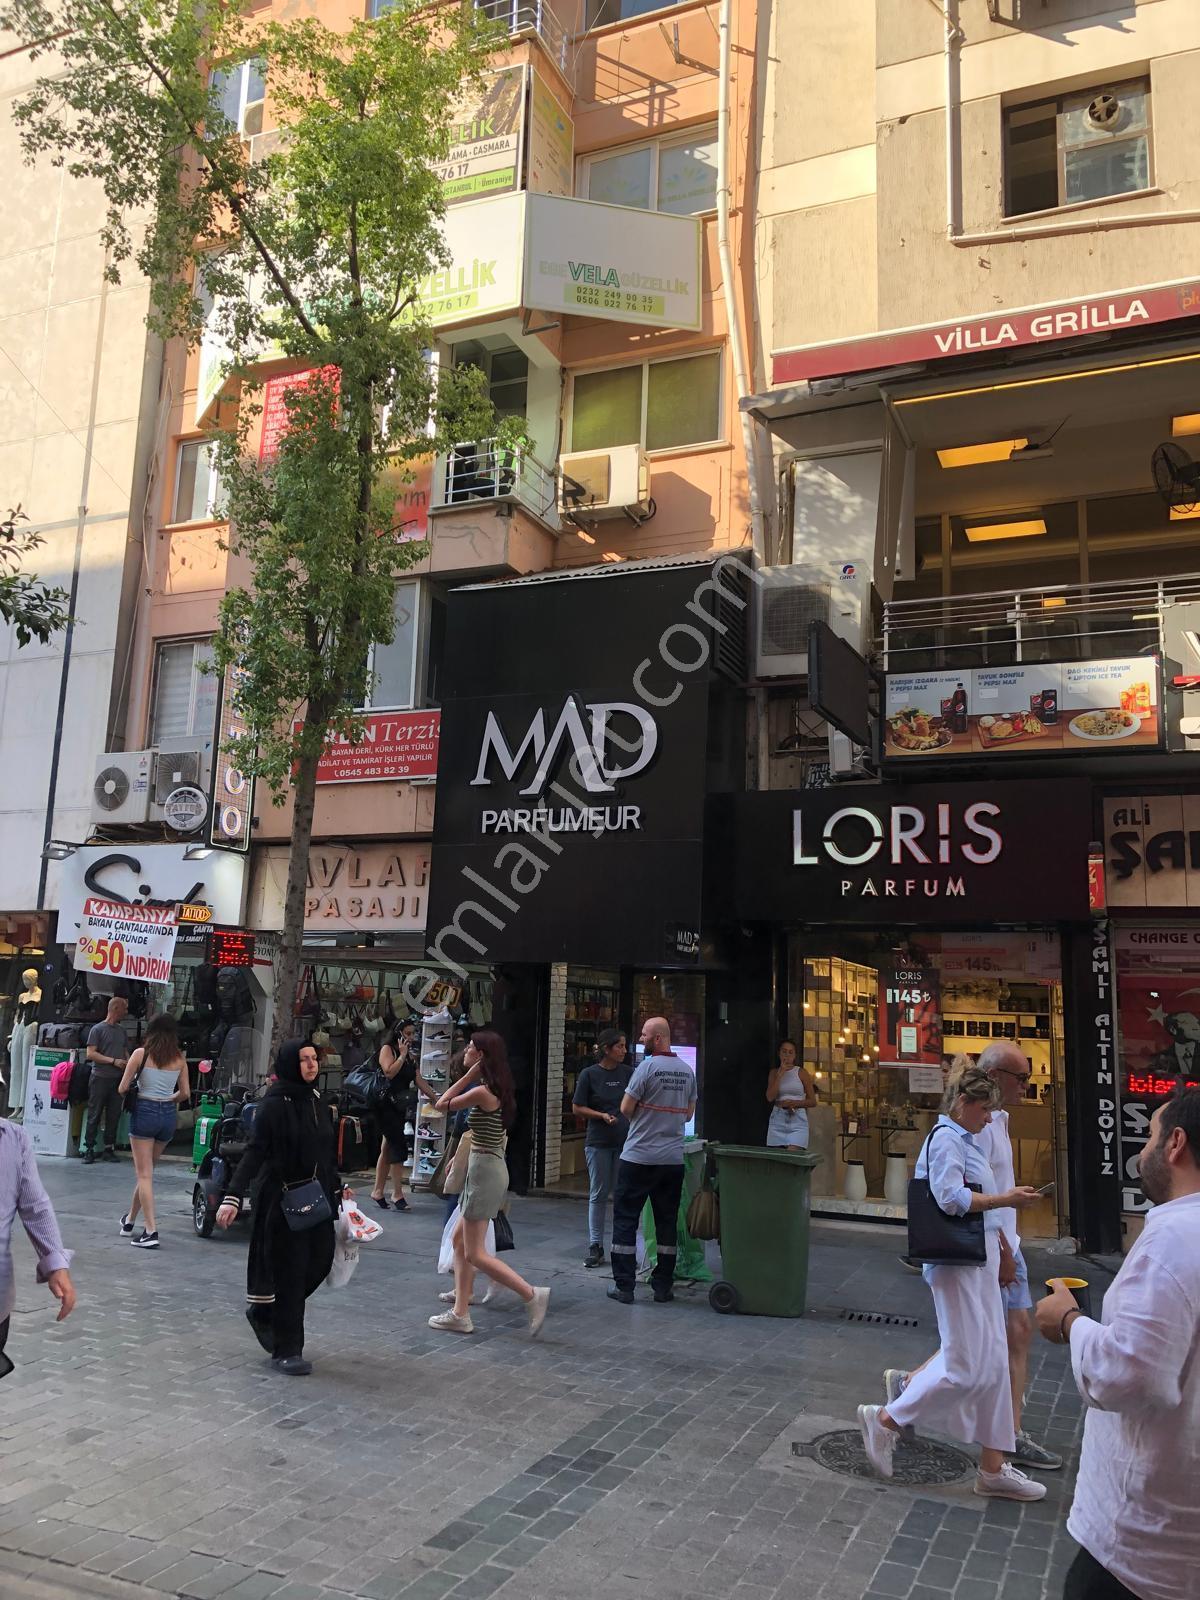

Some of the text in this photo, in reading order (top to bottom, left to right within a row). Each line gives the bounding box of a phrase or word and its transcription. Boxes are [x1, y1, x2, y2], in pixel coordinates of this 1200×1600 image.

[473, 139, 510, 156] CASMARA
[458, 163, 469, 177] 17
[567, 260, 621, 289] VELA
[457, 294, 471, 308] 17
[576, 286, 653, 304] 0232 249 00 35
[576, 295, 653, 313] 0506 022 76 17
[934, 298, 1150, 353] VİLLA GRİLLA
[331, 749, 354, 757] BAYAN
[375, 745, 394, 753] KÜRK
[395, 744, 410, 752] HER
[411, 741, 434, 751] TÜRLÜ
[469, 694, 659, 796] MAD
[317, 759, 340, 768] ADİLAT
[353, 757, 382, 766] TAMİRAT
[384, 755, 405, 764] İŞLERİ
[406, 754, 433, 762] YAPILIR
[340, 765, 410, 777] 0545 483 82 39
[481, 804, 641, 834] PARFUMEUR
[1112, 803, 1150, 827] ALİ
[792, 801, 1002, 865] LORIS
[841, 875, 966, 896] PARFUM
[89, 899, 177, 925] KAMPANYA
[88, 917, 174, 937] BAYAN ÇANTALARINDA
[1130, 932, 1188, 944] CHANGE
[125, 949, 171, 981] İNDİRİM
[896, 971, 922, 981] LORIS
[1095, 1014, 1113, 1085] ALTIN
[1098, 1098, 1115, 1176] DÖVİZ
